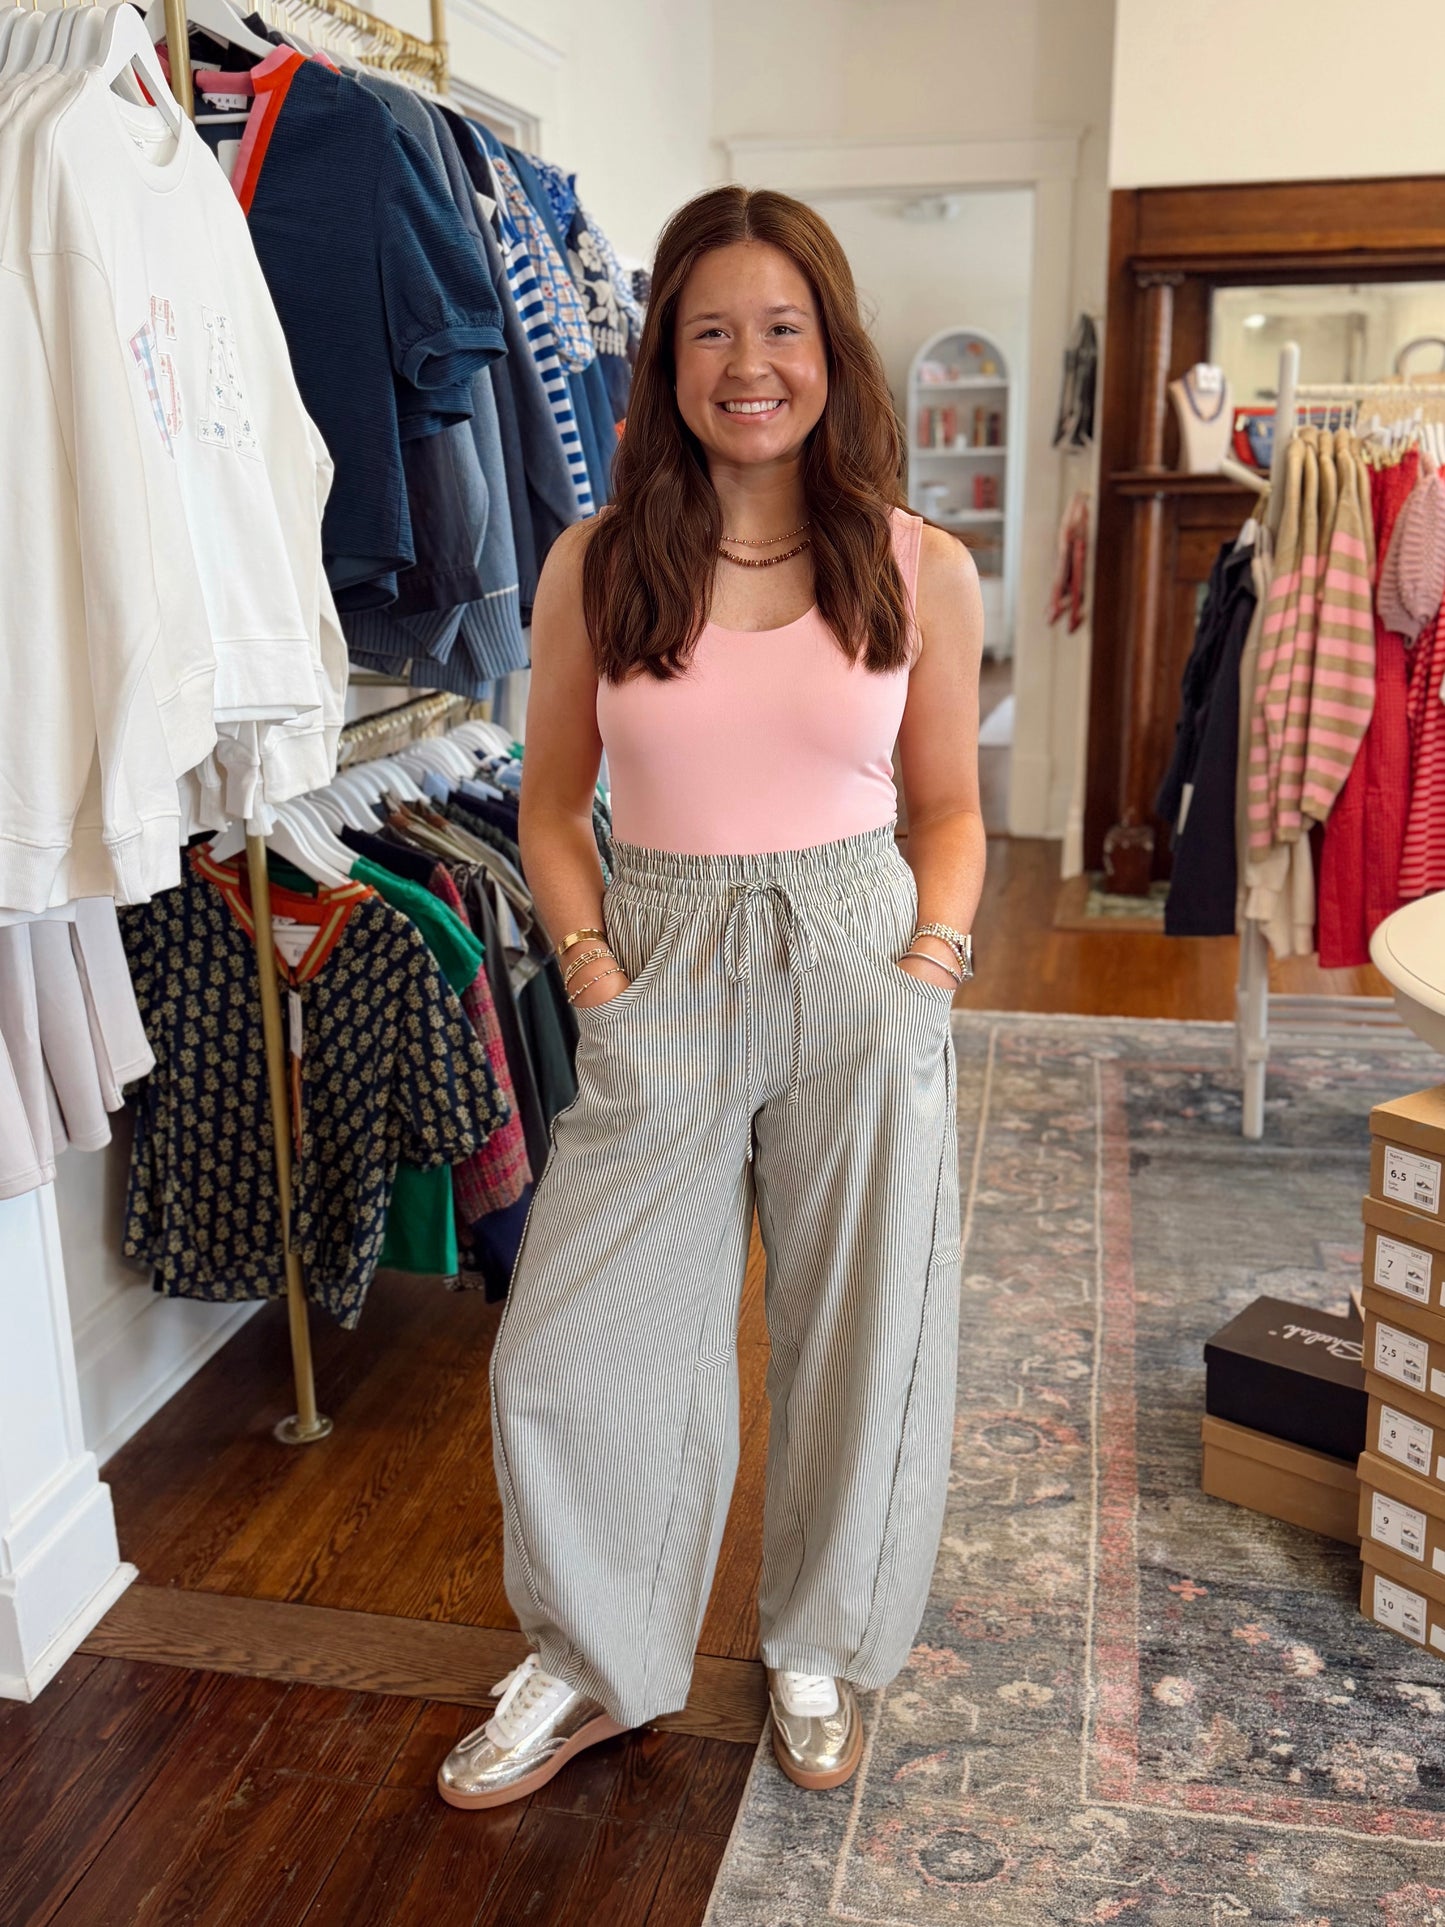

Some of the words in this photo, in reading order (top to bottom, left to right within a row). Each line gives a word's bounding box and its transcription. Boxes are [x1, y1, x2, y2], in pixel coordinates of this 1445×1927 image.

[1390, 1169, 1407, 1182] 6.5
[1387, 1259, 1394, 1269] 7
[1381, 1344, 1397, 1358] 7.5
[1390, 1430, 1396, 1439] 8
[1383, 1516, 1389, 1524] 9
[1382, 1598, 1394, 1610] 10
